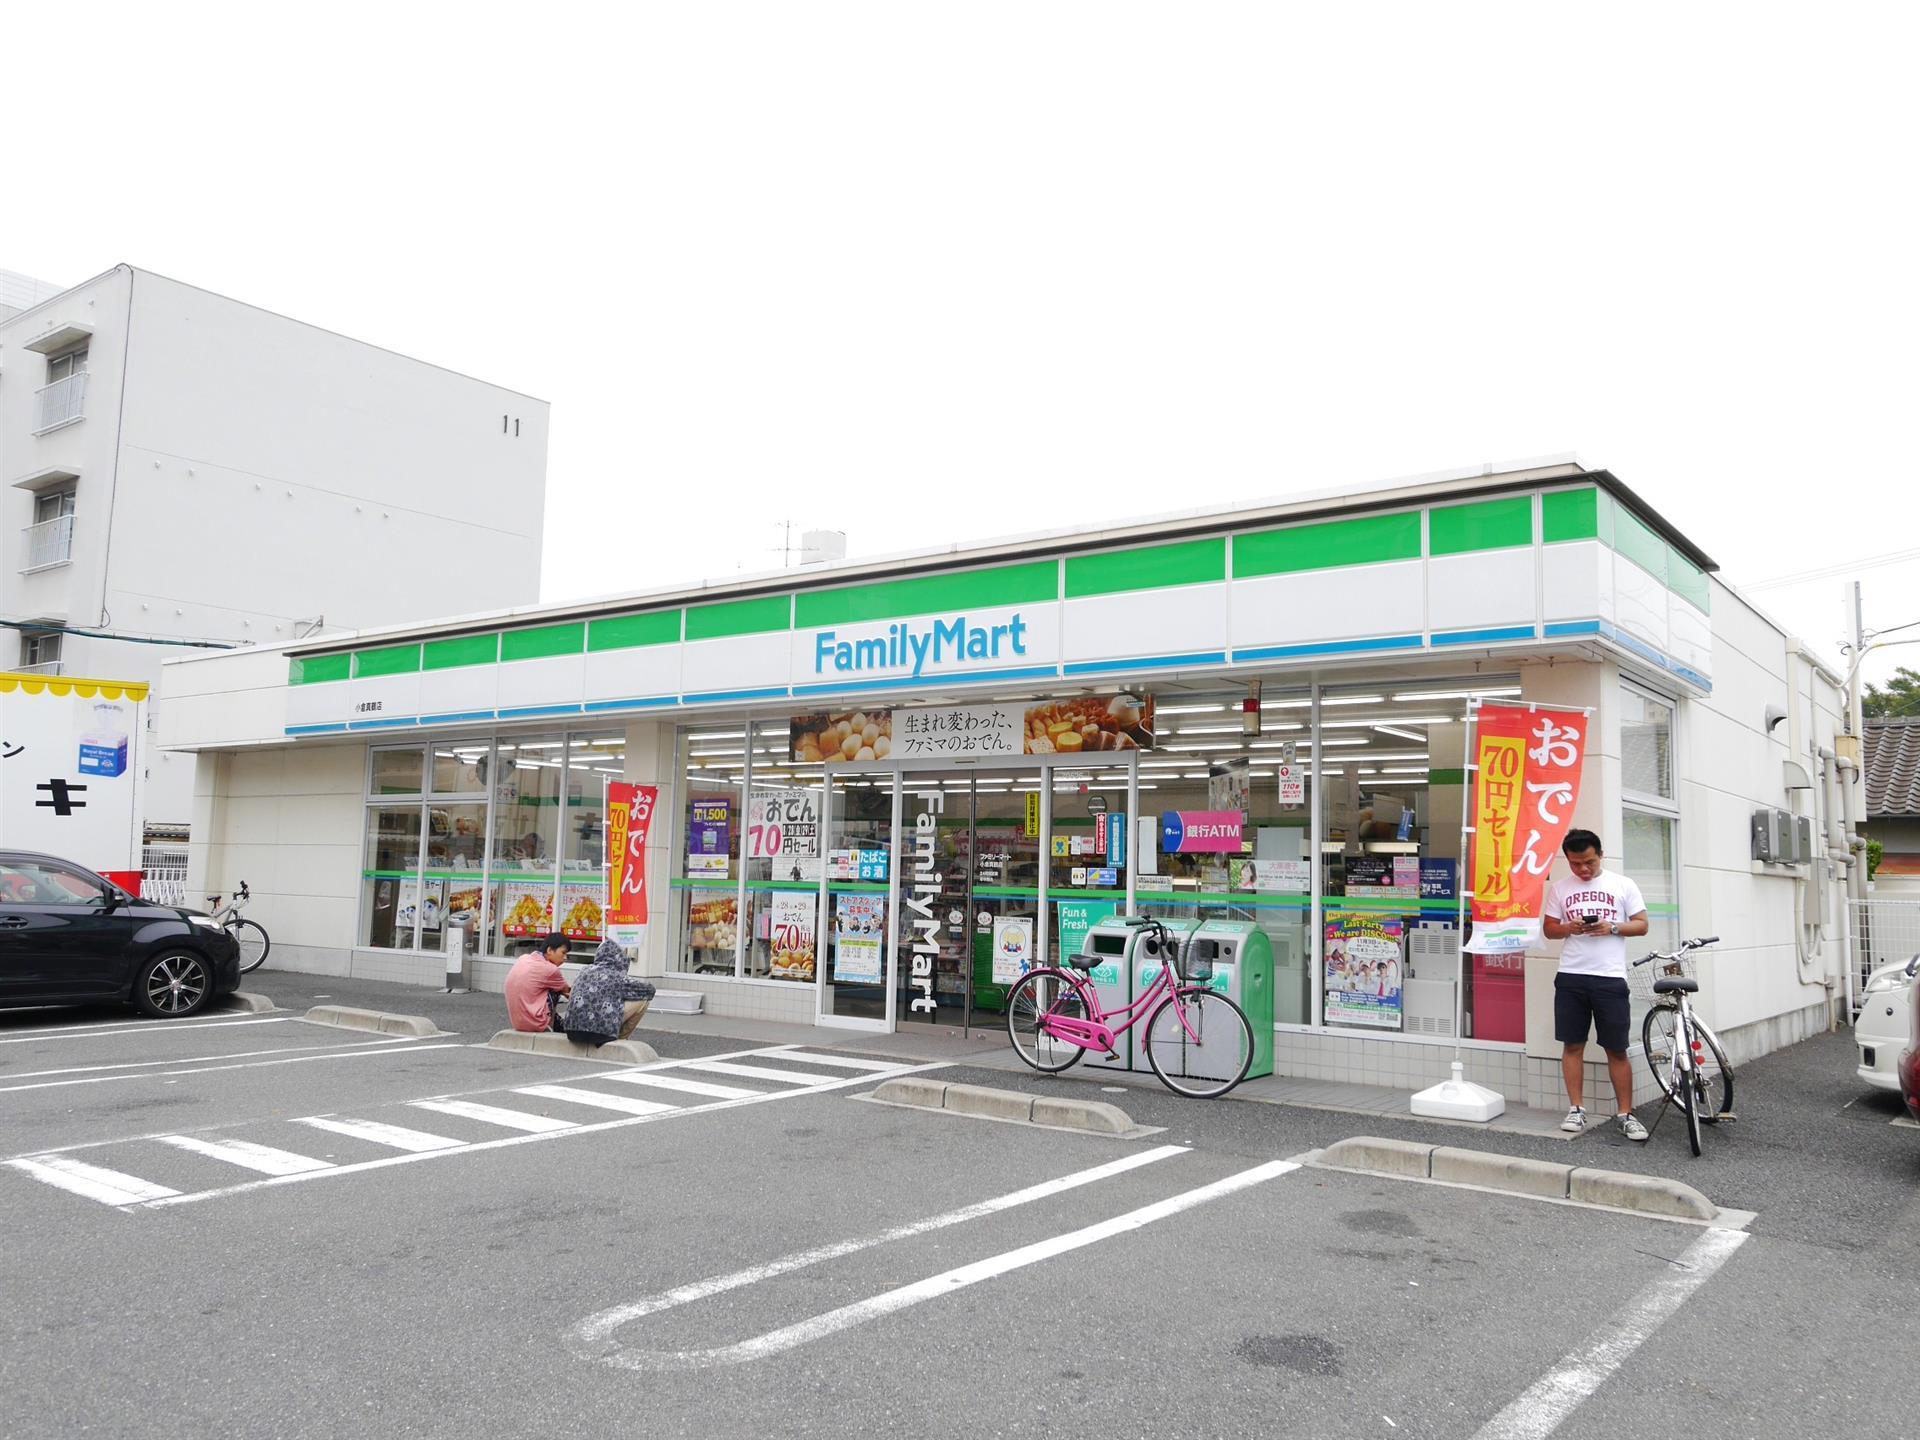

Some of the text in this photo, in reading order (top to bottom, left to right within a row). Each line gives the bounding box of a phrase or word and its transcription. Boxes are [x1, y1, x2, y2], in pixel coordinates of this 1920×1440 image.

[503, 414, 520, 437] 11
[815, 613, 1027, 678] FamilyMart
[904, 710, 1013, 734] 生まれ変わった、
[904, 732, 1013, 753] ファミマのおでん。
[35, 778, 88, 816] キ
[1512, 717, 1581, 876] おでん
[766, 798, 816, 822] おでん
[1481, 744, 1520, 897] 70円セール
[621, 789, 652, 895] おでん
[749, 824, 782, 856] 70
[1187, 824, 1240, 838] 銀行ATM
[783, 838, 816, 854] 円セール
[860, 850, 887, 864] たばこ
[906, 790, 944, 1013] FamilyMart
[1565, 890, 1615, 908] OREGON
[1062, 907, 1087, 918] Fun &
[1062, 918, 1088, 930] Fresh
[1343, 920, 1385, 931] Last Party
